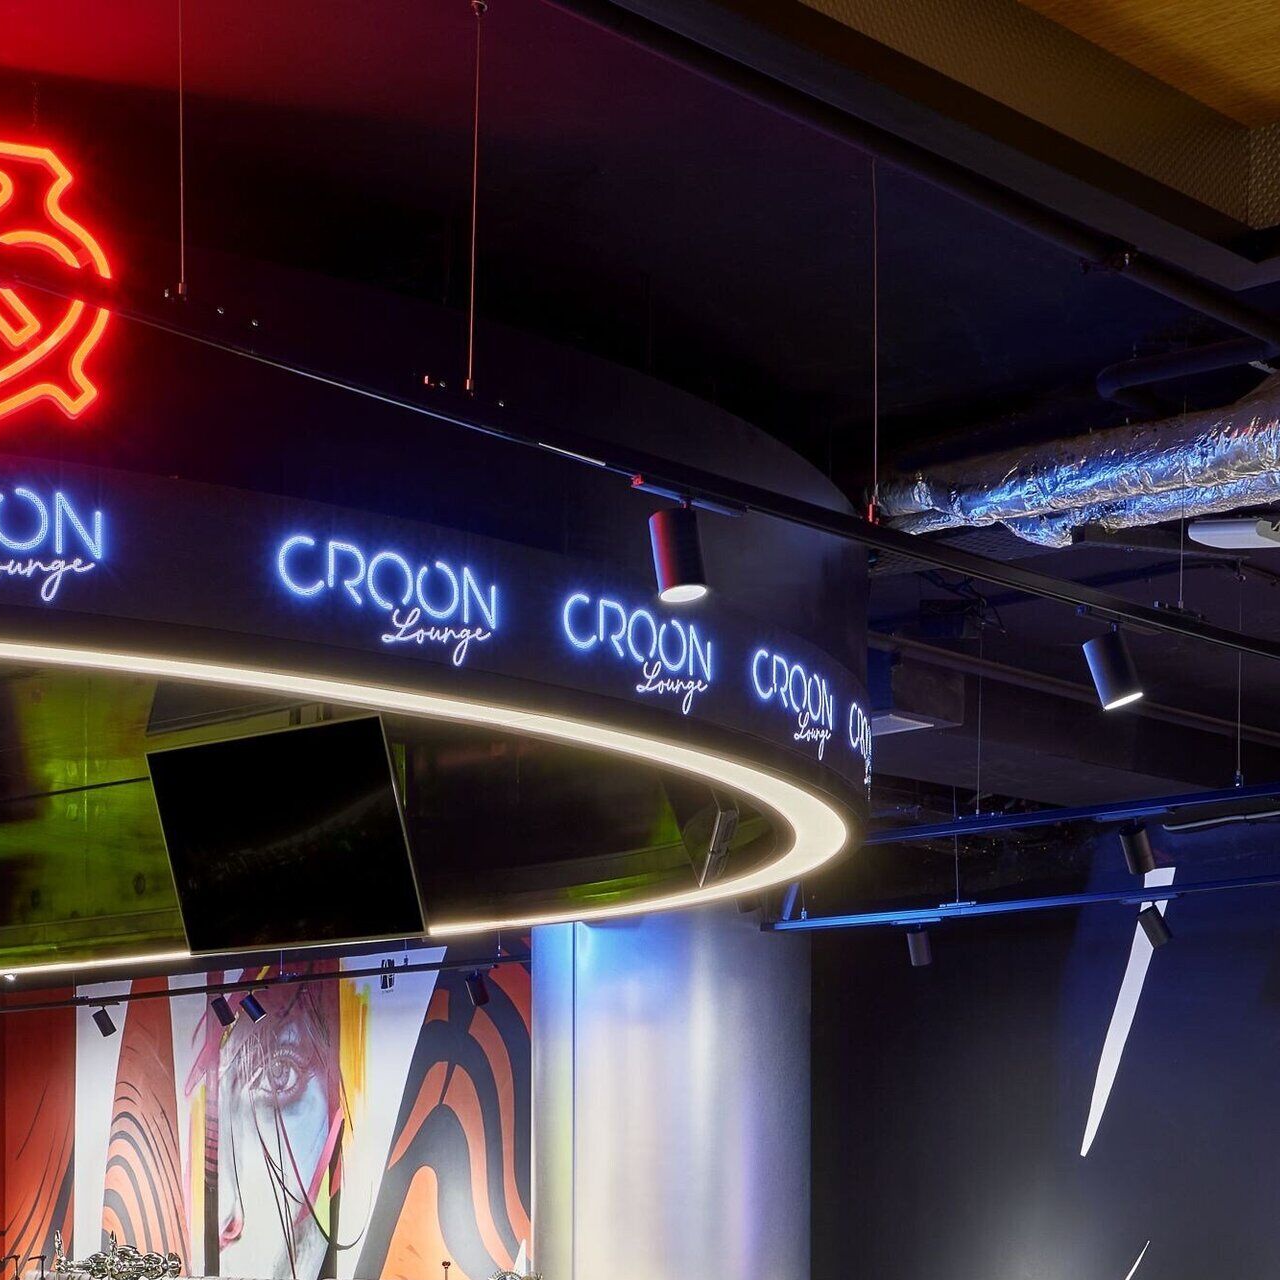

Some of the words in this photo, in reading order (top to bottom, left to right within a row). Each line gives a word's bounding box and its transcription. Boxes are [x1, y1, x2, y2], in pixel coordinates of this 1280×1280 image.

[276, 534, 499, 629] CROON
[381, 607, 492, 667] Lounge
[562, 592, 712, 681] CROON
[635, 660, 709, 715] Lounge
[753, 649, 833, 731] CROON
[793, 711, 832, 761] Lounge
